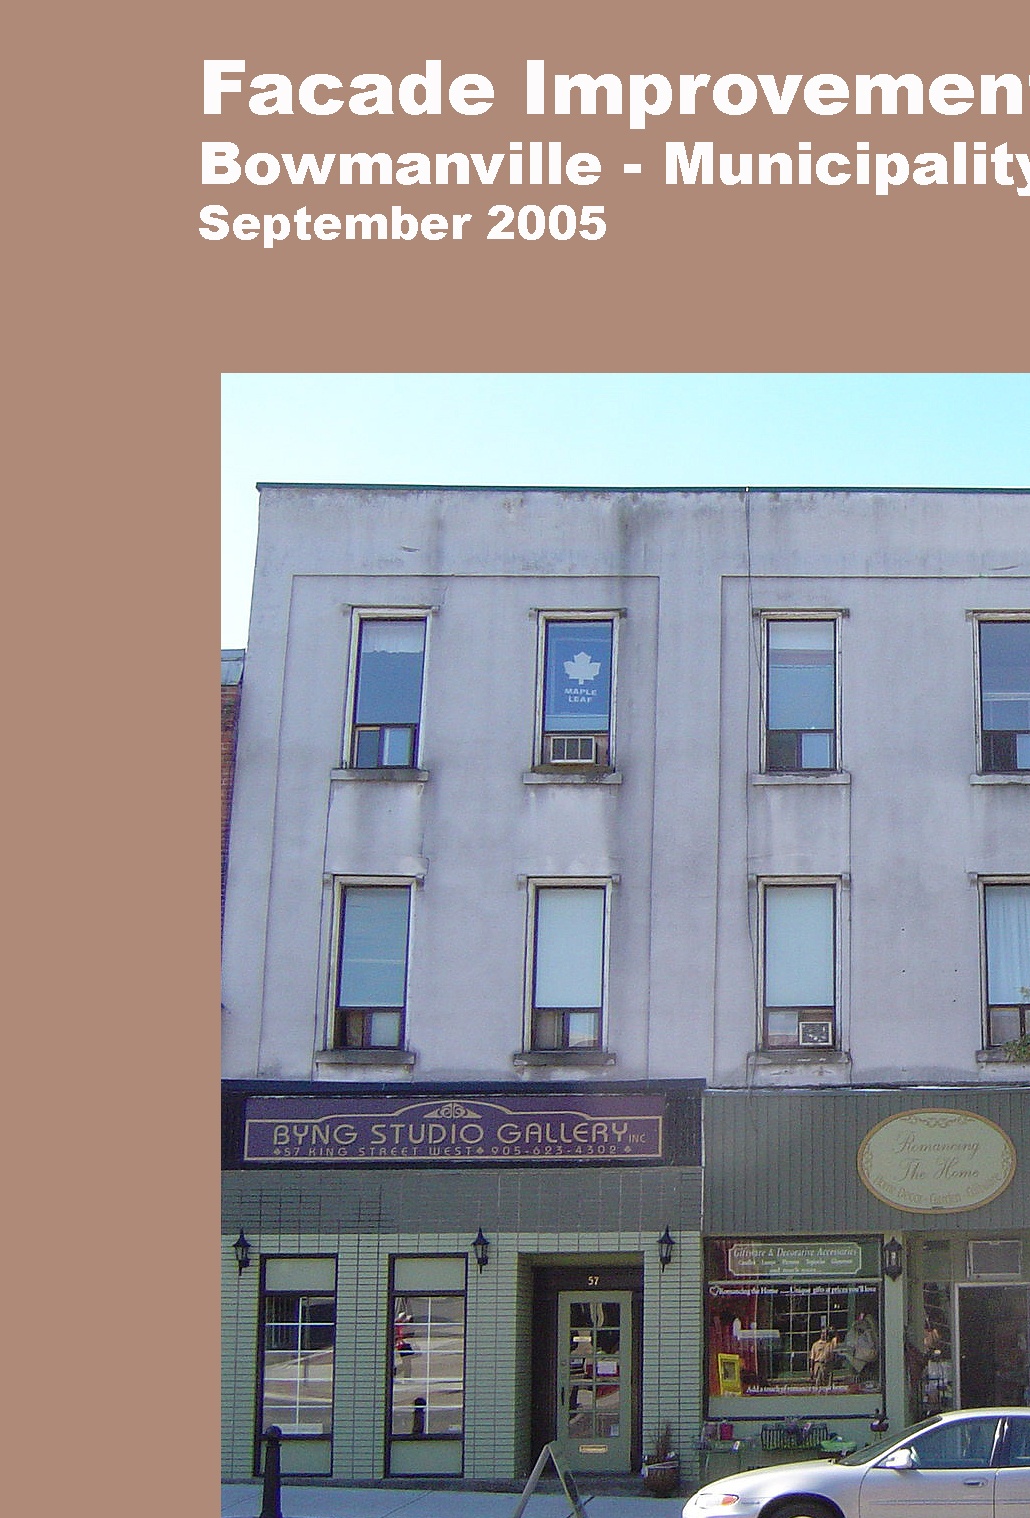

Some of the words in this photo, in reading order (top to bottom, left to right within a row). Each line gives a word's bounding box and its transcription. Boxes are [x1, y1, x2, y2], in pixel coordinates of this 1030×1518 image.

[564, 688, 598, 696] MAPLE
[273, 1124, 358, 1145] BYNG
[370, 1124, 484, 1144] STUDIO
[497, 1122, 628, 1144] GALLERY
[894, 1131, 980, 1159] Romancing
[285, 1148, 300, 1156] 57
[308, 1148, 348, 1156] KING
[358, 1147, 418, 1156] STREET
[428, 1146, 471, 1156] WEST
[492, 1146, 616, 1155] 905-623-4302
[897, 1158, 925, 1182] The
[934, 1157, 979, 1180] Home
[777, 1248, 815, 1258] Decorative
[588, 1276, 600, 1286] 57
